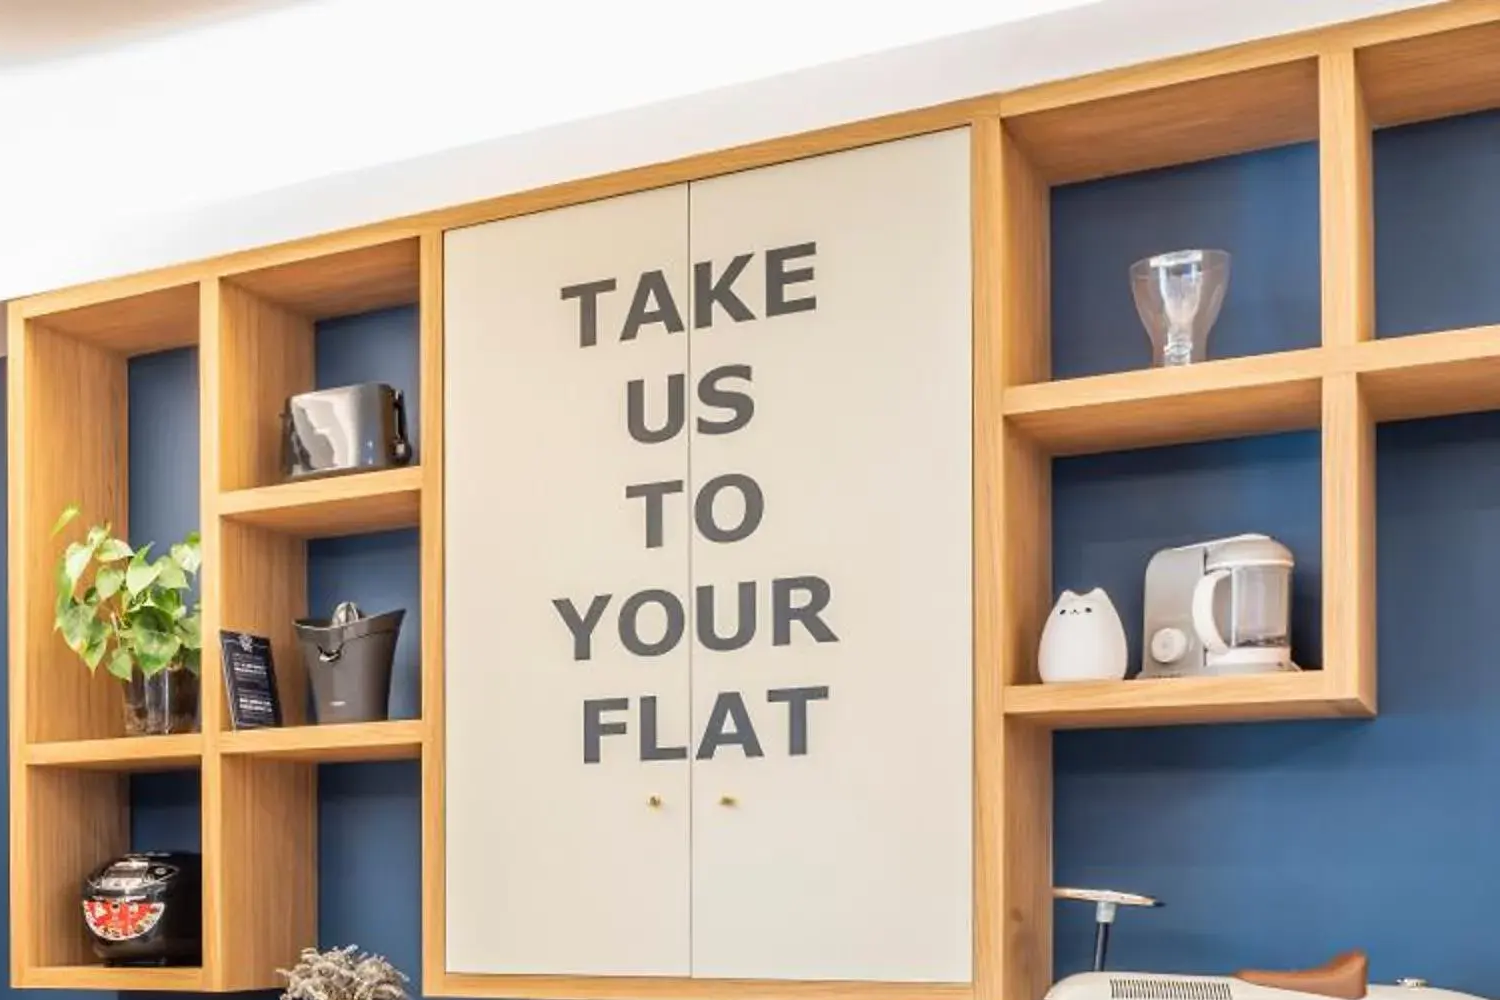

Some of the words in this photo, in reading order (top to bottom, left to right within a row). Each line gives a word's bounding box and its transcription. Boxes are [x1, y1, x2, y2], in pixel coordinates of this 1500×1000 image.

[561, 241, 817, 348] TAKE
[626, 364, 756, 445] US
[625, 473, 765, 549] TO
[552, 575, 840, 662] YOUR
[583, 685, 830, 764] FLAT
